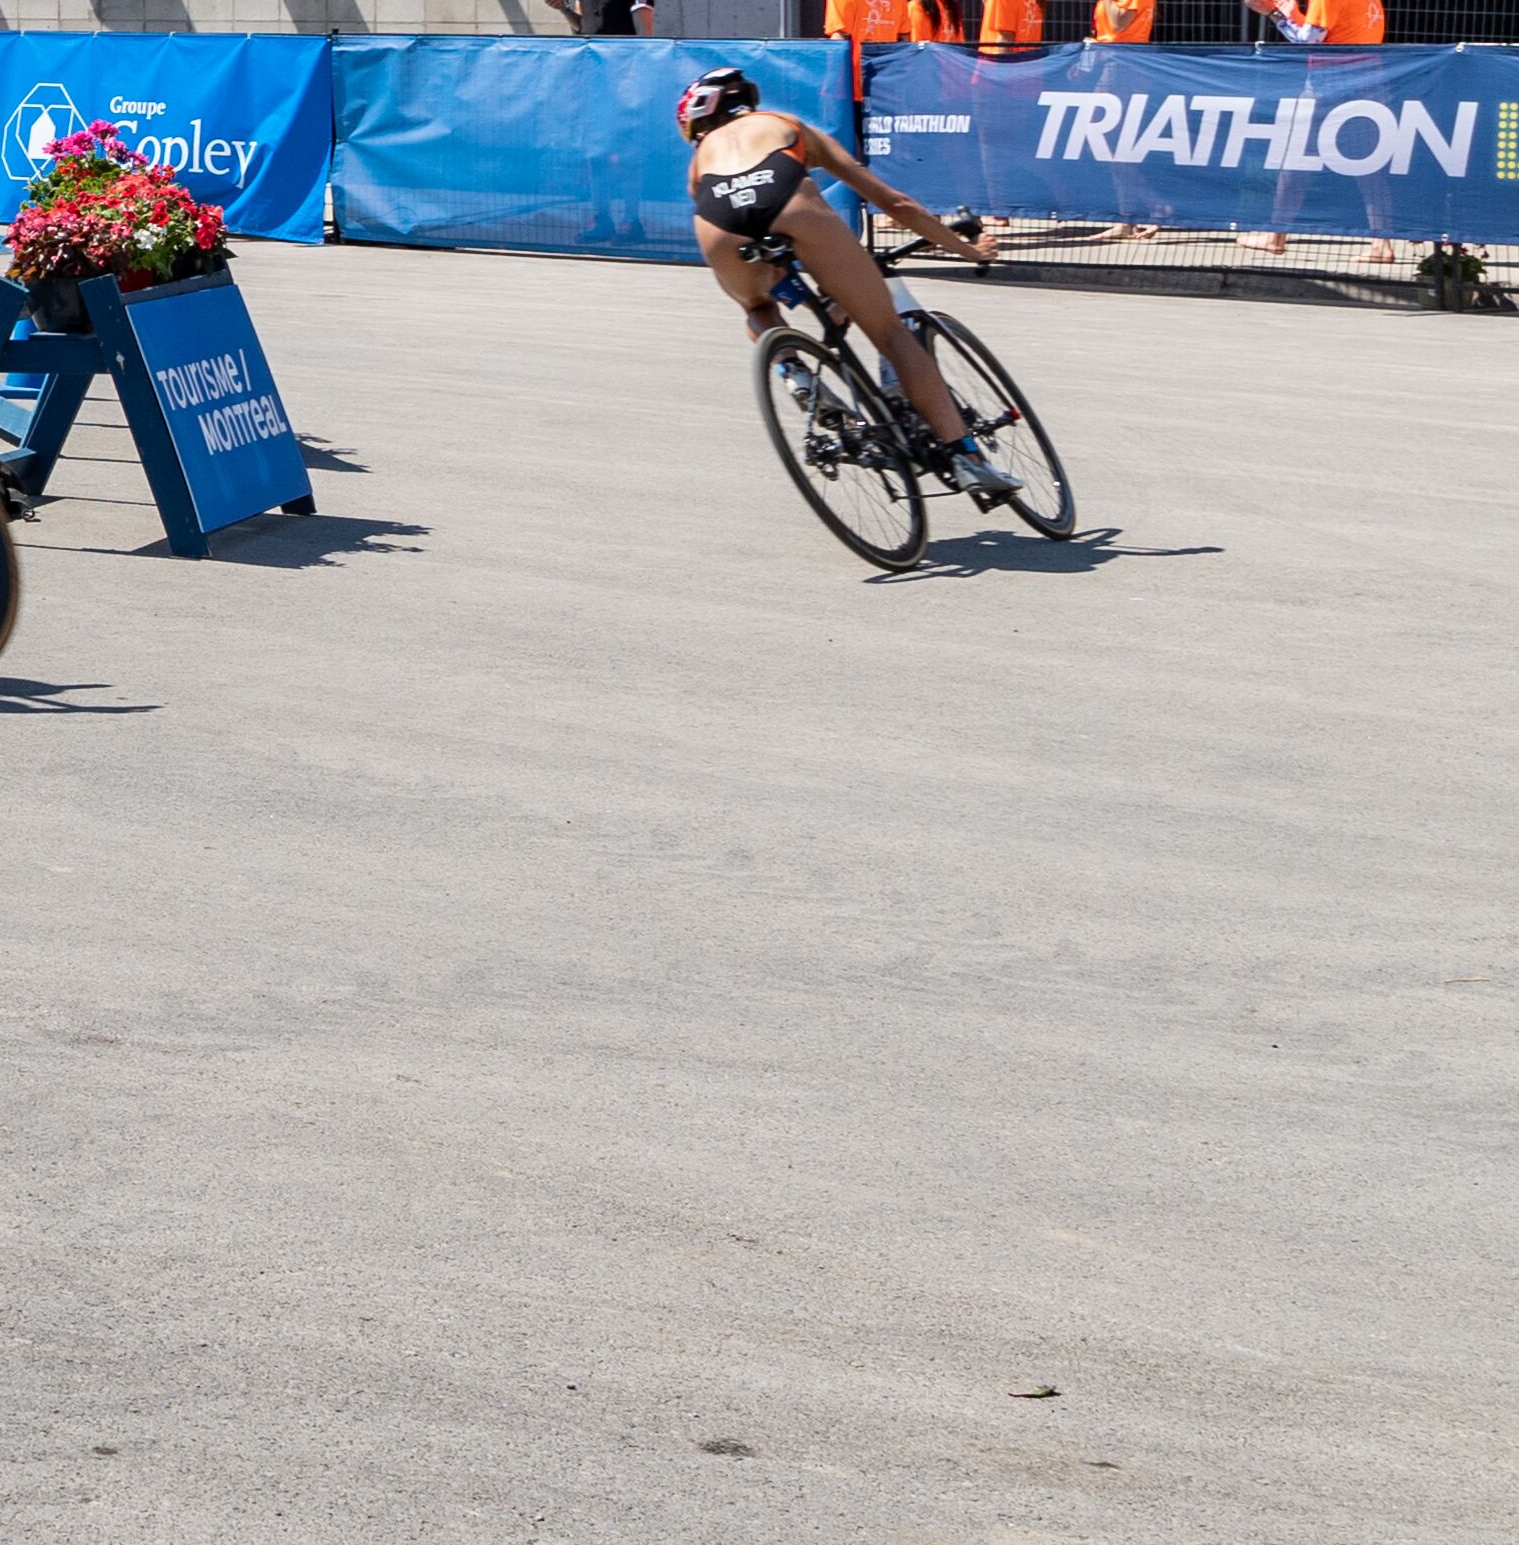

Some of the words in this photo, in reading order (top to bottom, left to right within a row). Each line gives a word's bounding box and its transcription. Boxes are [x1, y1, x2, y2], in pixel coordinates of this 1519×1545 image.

[109, 96, 166, 119] Groupe
[894, 115, 971, 133] TRIATHLON
[1034, 90, 1479, 178] TRIATHLON
[712, 169, 774, 198] KLAMER
